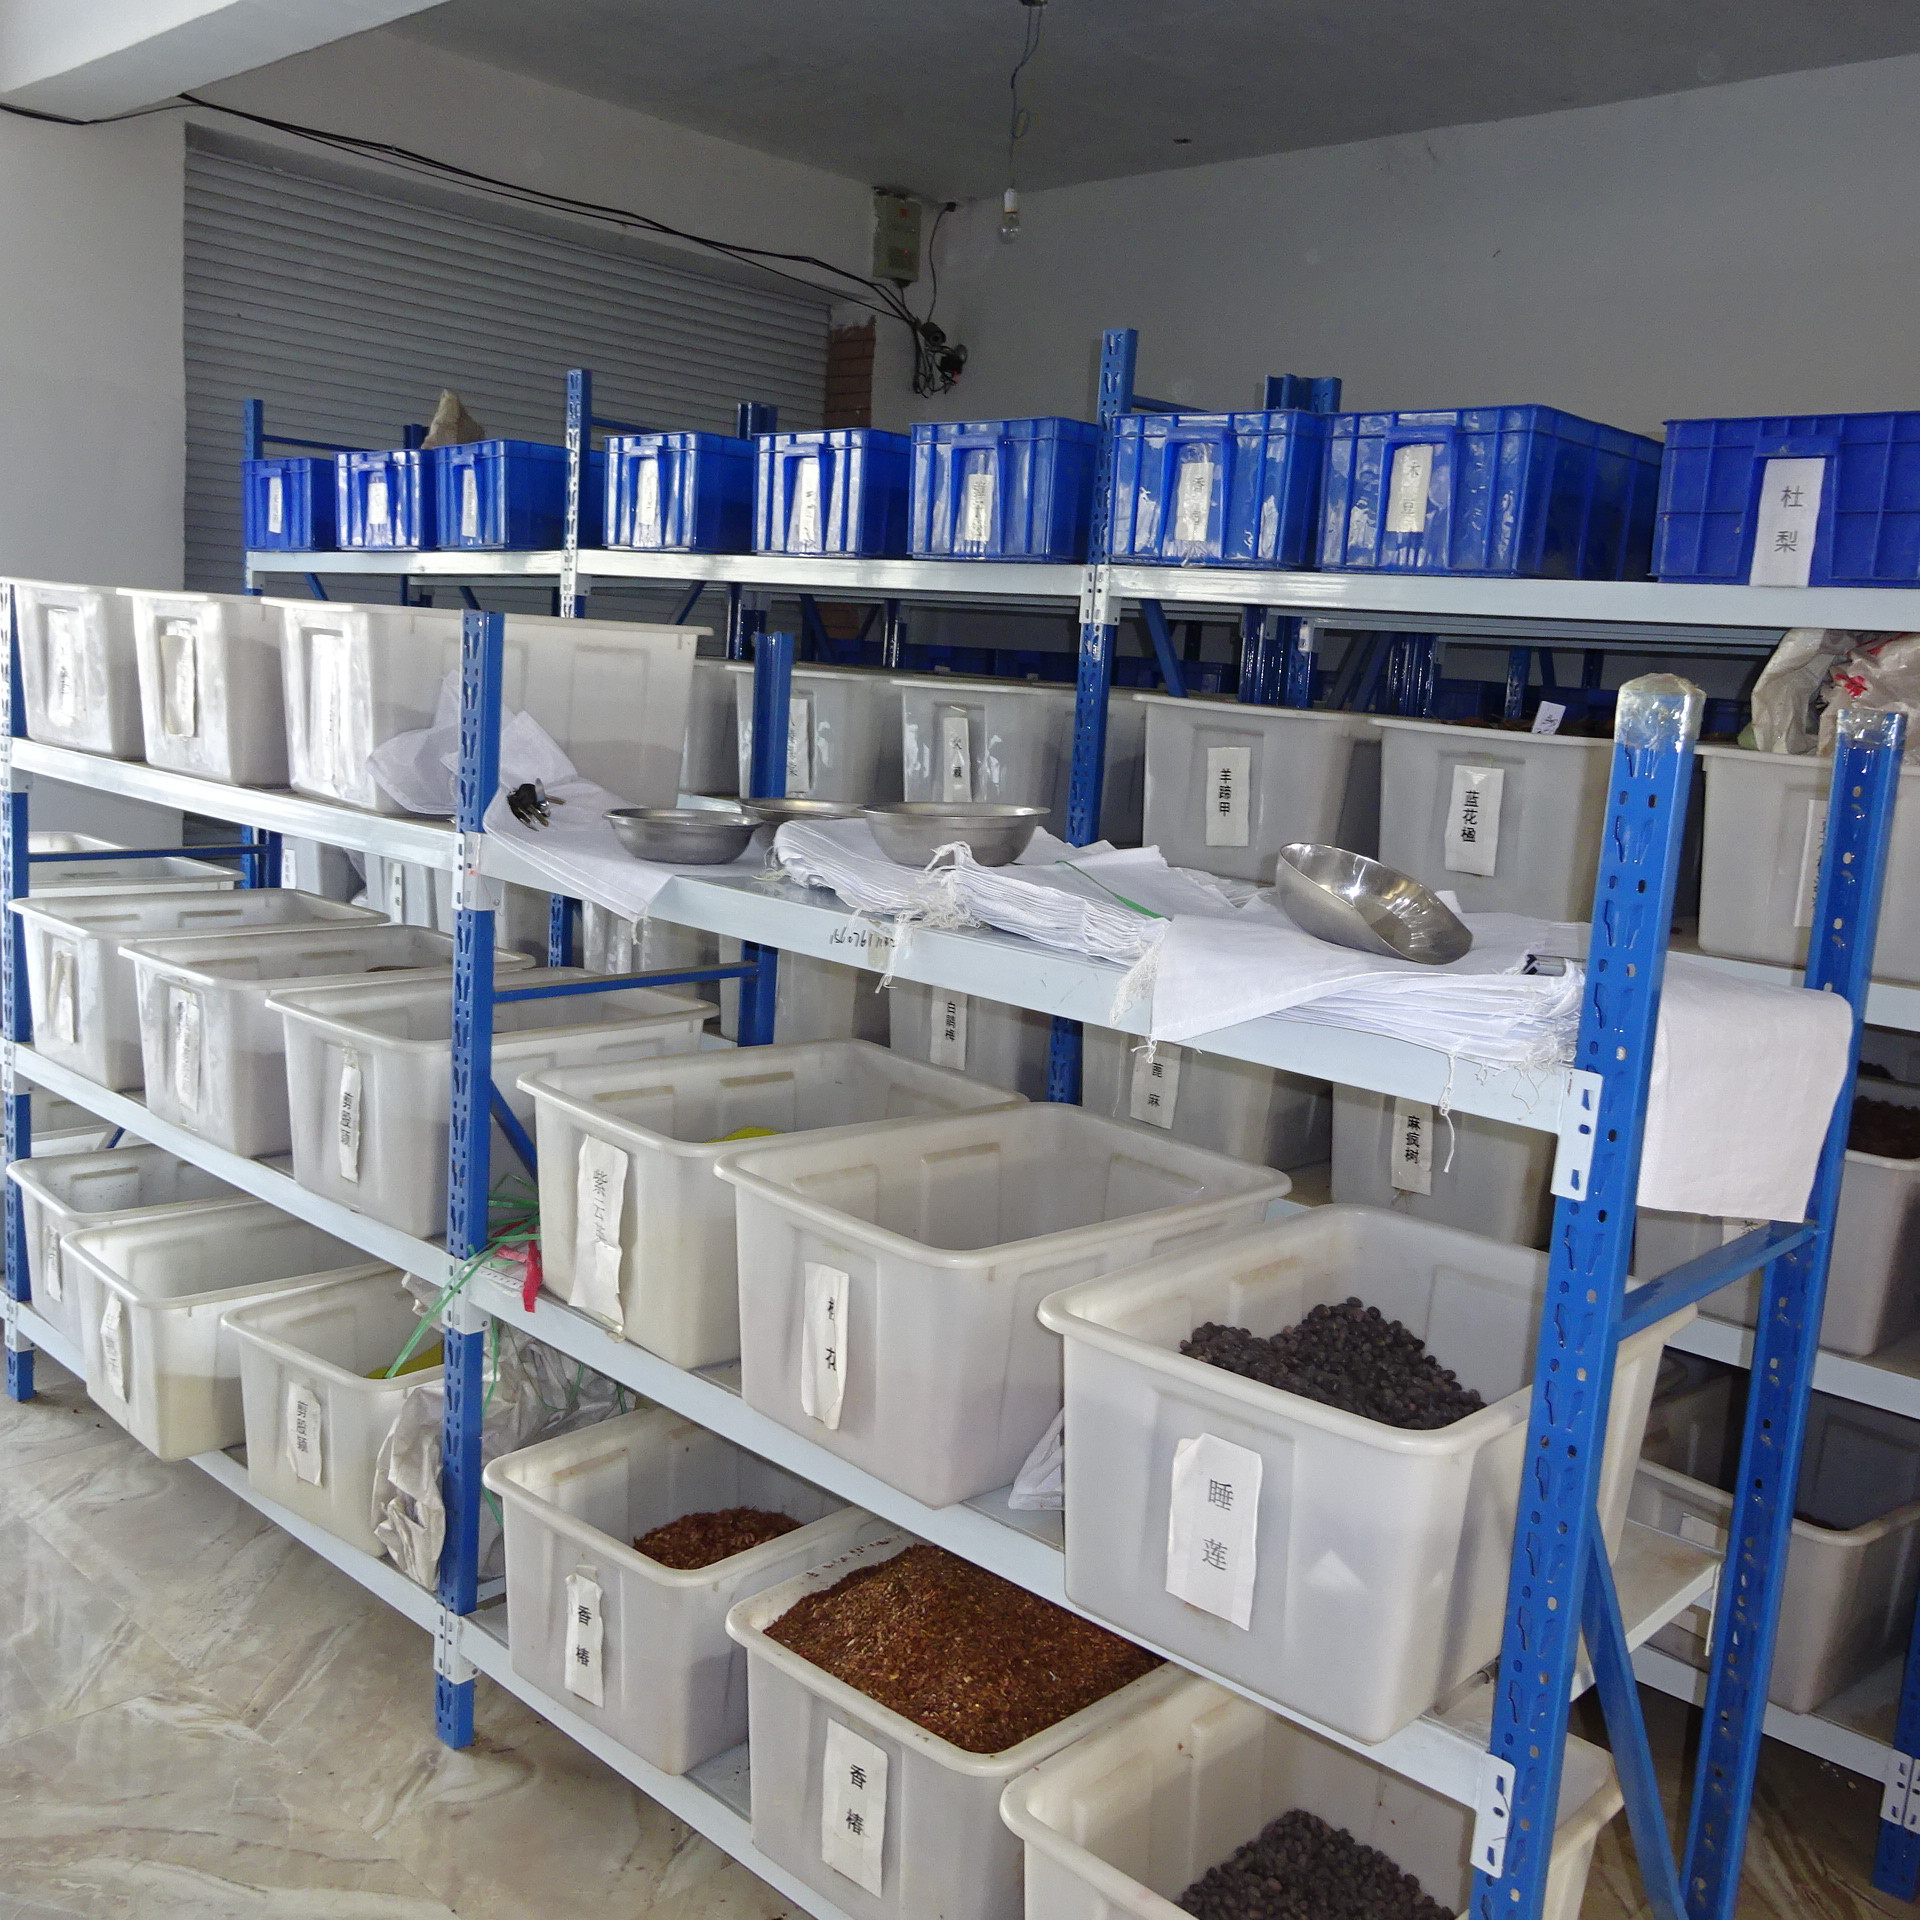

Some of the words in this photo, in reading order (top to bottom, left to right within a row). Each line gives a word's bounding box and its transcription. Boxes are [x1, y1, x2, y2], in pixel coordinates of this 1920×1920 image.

[1773, 485, 1804, 553] 杜梨
[1218, 768, 1232, 817] 羊蹄甲
[1461, 791, 1480, 843] 蓝花楹
[1148, 1062, 1164, 1107] 蓖麻
[1405, 1115, 1421, 1164] 麻疯树
[1202, 1479, 1233, 1571] 睡莲
[576, 1605, 592, 1667] 香椿
[846, 1764, 868, 1836] 香椿
